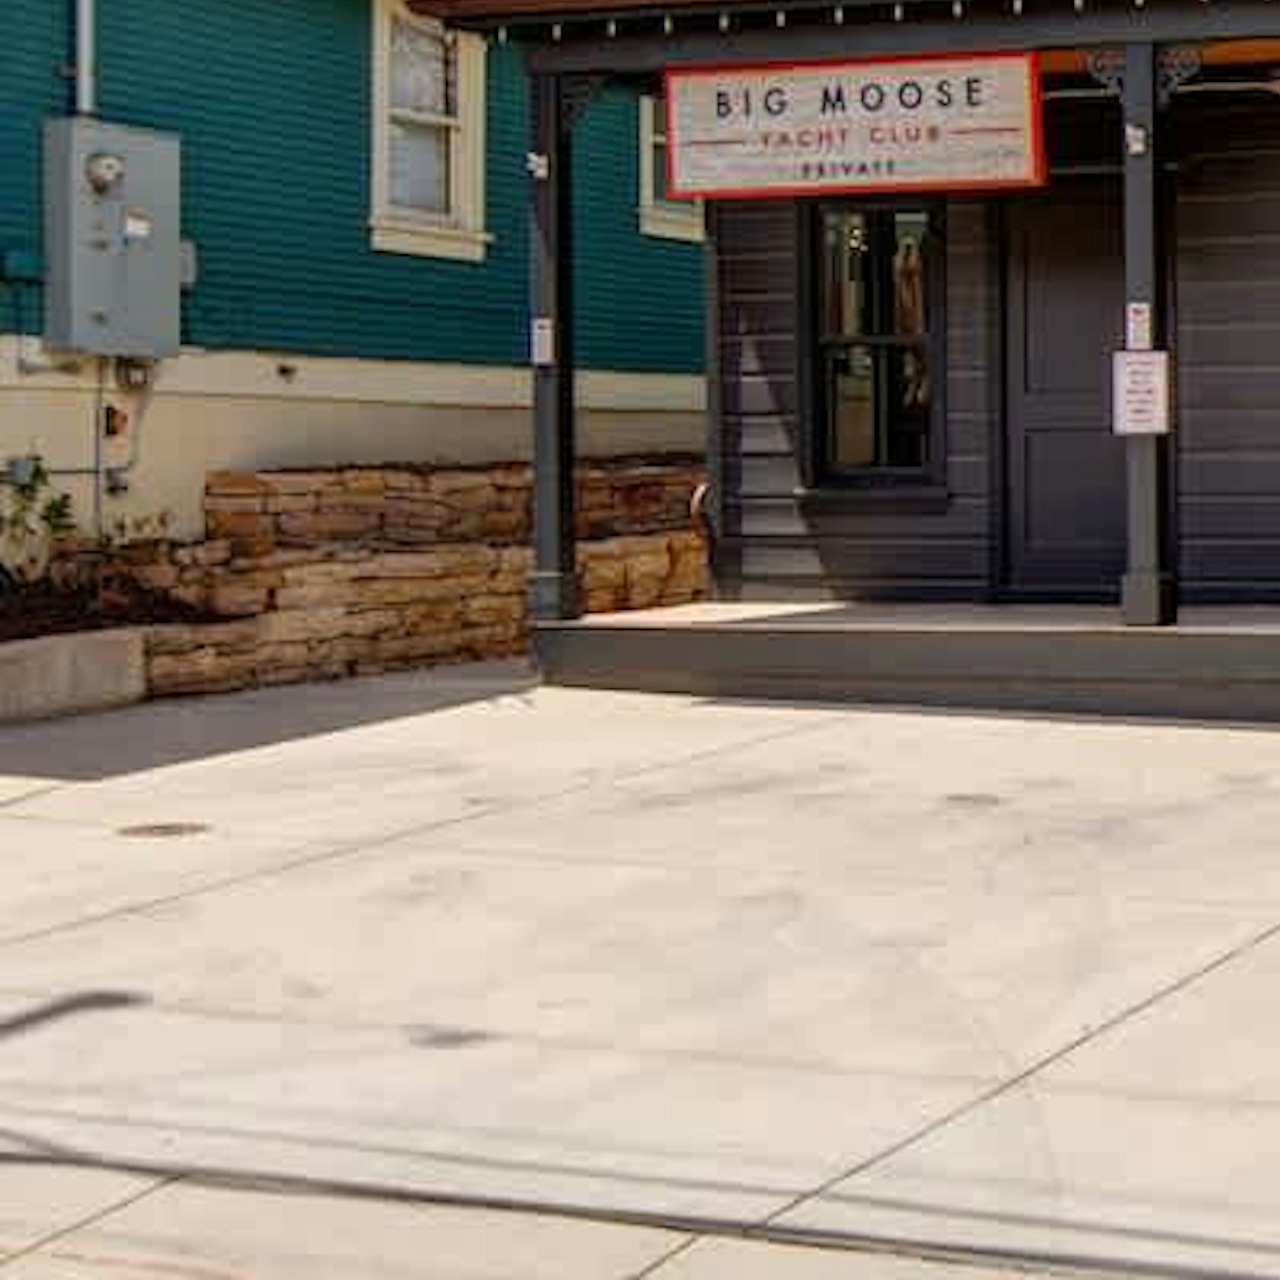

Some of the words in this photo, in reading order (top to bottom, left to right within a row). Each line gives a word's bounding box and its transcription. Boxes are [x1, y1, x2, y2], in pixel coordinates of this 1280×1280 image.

[716, 87, 788, 118] BIG
[821, 78, 982, 115] MOOSE
[760, 127, 848, 150] YACHT
[870, 124, 940, 144] CLUB
[802, 160, 895, 179] PRIVATE
